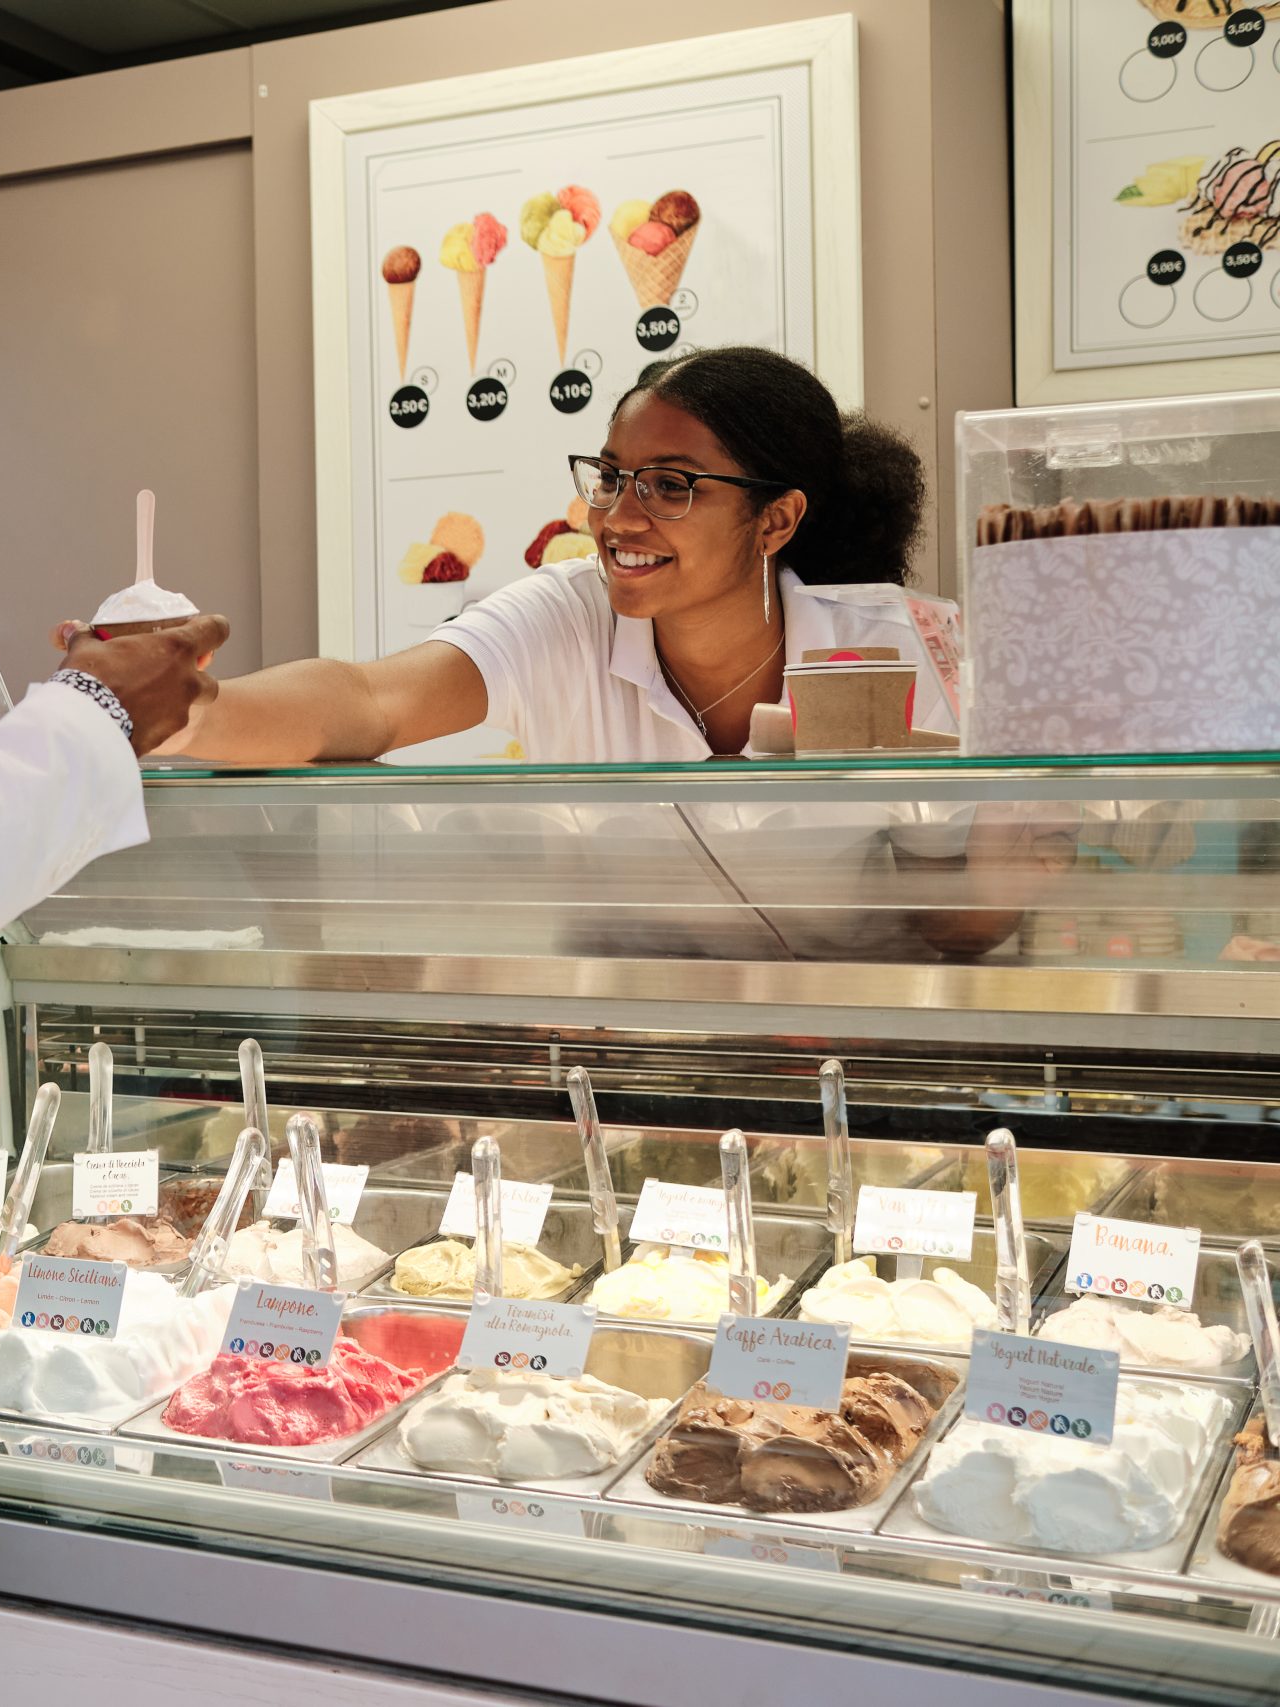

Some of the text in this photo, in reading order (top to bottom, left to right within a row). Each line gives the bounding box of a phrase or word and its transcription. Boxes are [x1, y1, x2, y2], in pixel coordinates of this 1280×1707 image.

[1228, 20, 1262, 35] 3,50€
[1151, 32, 1184, 47] 3,00€
[1150, 260, 1183, 275] 3,00€
[1226, 253, 1259, 268] 3,50€
[637, 319, 678, 338] 3,50€
[497, 367, 508, 378] M
[584, 358, 592, 369] L
[420, 375, 429, 386] S
[468, 391, 507, 409] 3,20€
[550, 382, 591, 401] 4,10€
[391, 398, 428, 416] 2,50€
[1095, 1223, 1174, 1257] Banana.
[28, 1262, 122, 1288] Limone Siciliano.
[256, 1289, 319, 1319] Lampone.
[484, 1315, 574, 1342] alla Romagnola.
[726, 1324, 837, 1352] Caffè Arabica.
[990, 1341, 1100, 1375] Yogurt Naturale.
